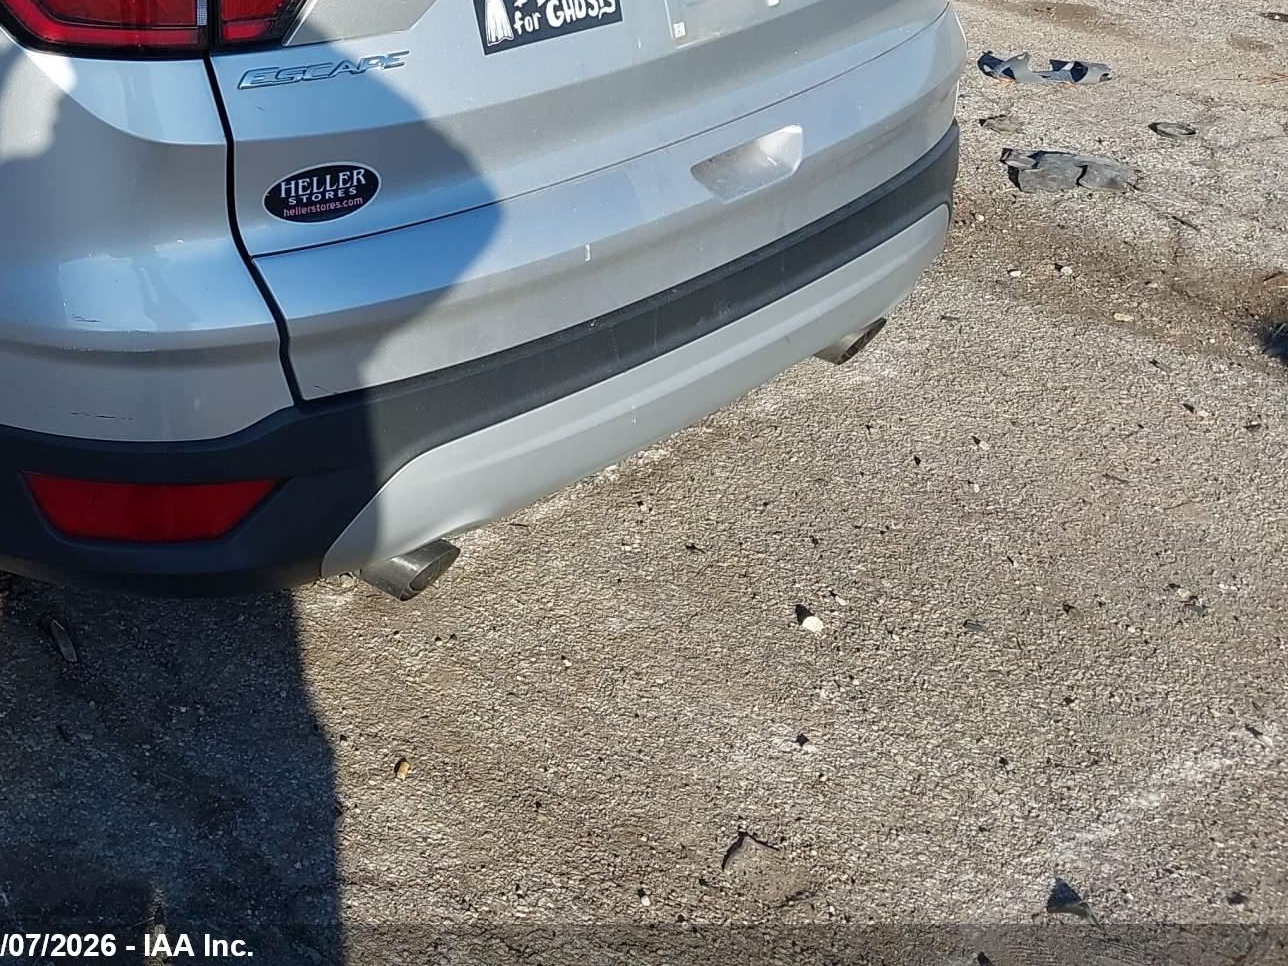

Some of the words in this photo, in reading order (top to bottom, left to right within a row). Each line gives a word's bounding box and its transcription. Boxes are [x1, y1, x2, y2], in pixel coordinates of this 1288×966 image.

[513, 10, 541, 35] for
[237, 49, 410, 90] ESCAPE
[279, 168, 366, 198] HELLER
[283, 196, 364, 217] hellerstores.com
[288, 187, 357, 206] STORES
